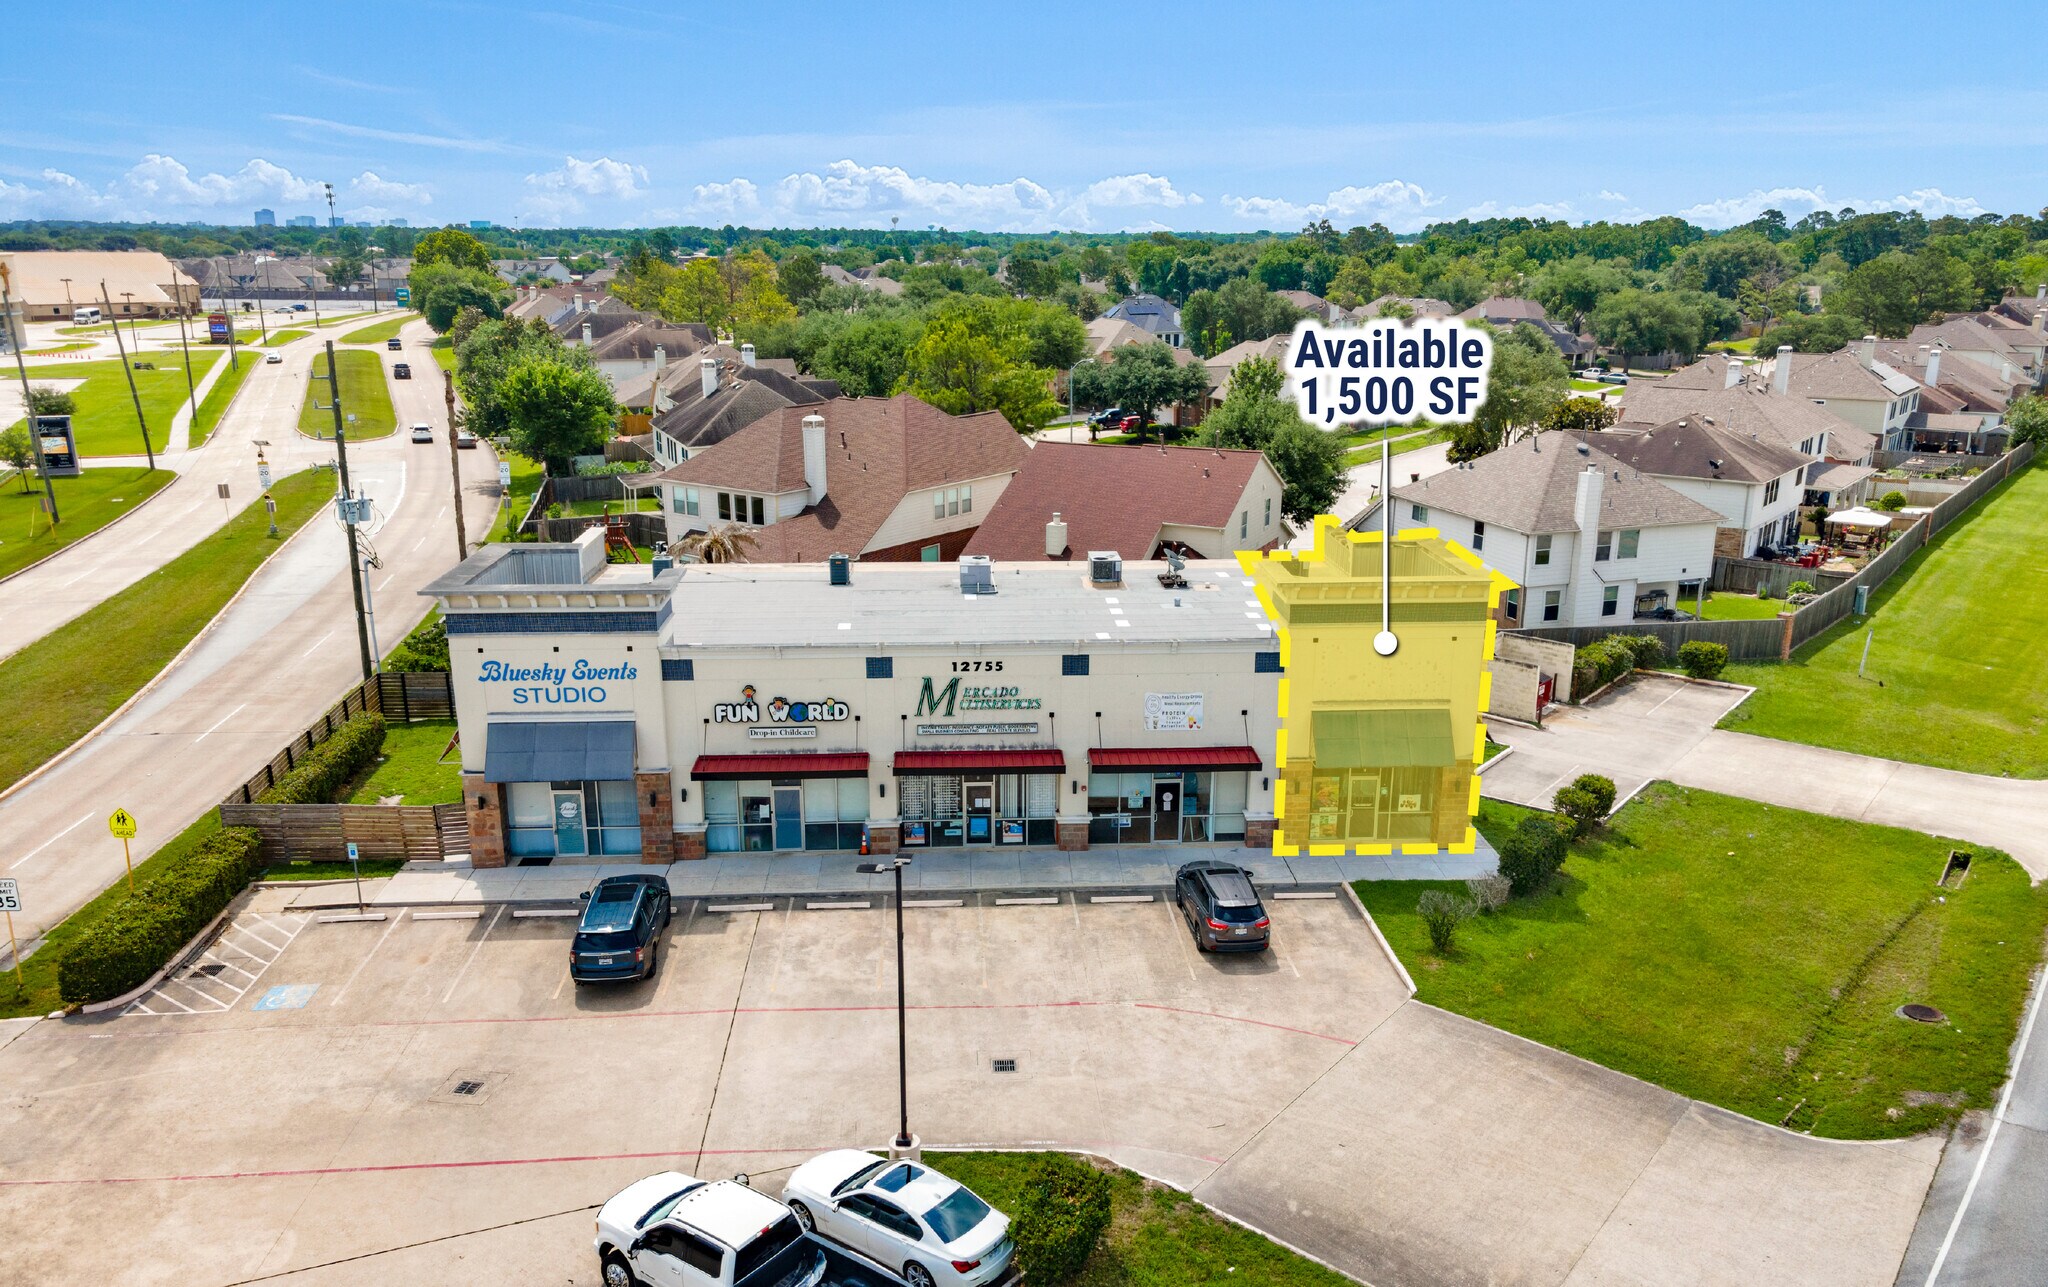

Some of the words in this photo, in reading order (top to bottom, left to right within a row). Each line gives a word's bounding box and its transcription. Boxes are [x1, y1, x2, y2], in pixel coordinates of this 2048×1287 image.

[478, 660, 566, 685] Bluesky
[572, 659, 638, 680] Events
[952, 661, 1003, 672] 12755
[513, 687, 606, 704] STUDIO
[715, 703, 759, 723] FUN
[750, 729, 777, 738] Drop-in
[780, 727, 815, 737] Childcare
